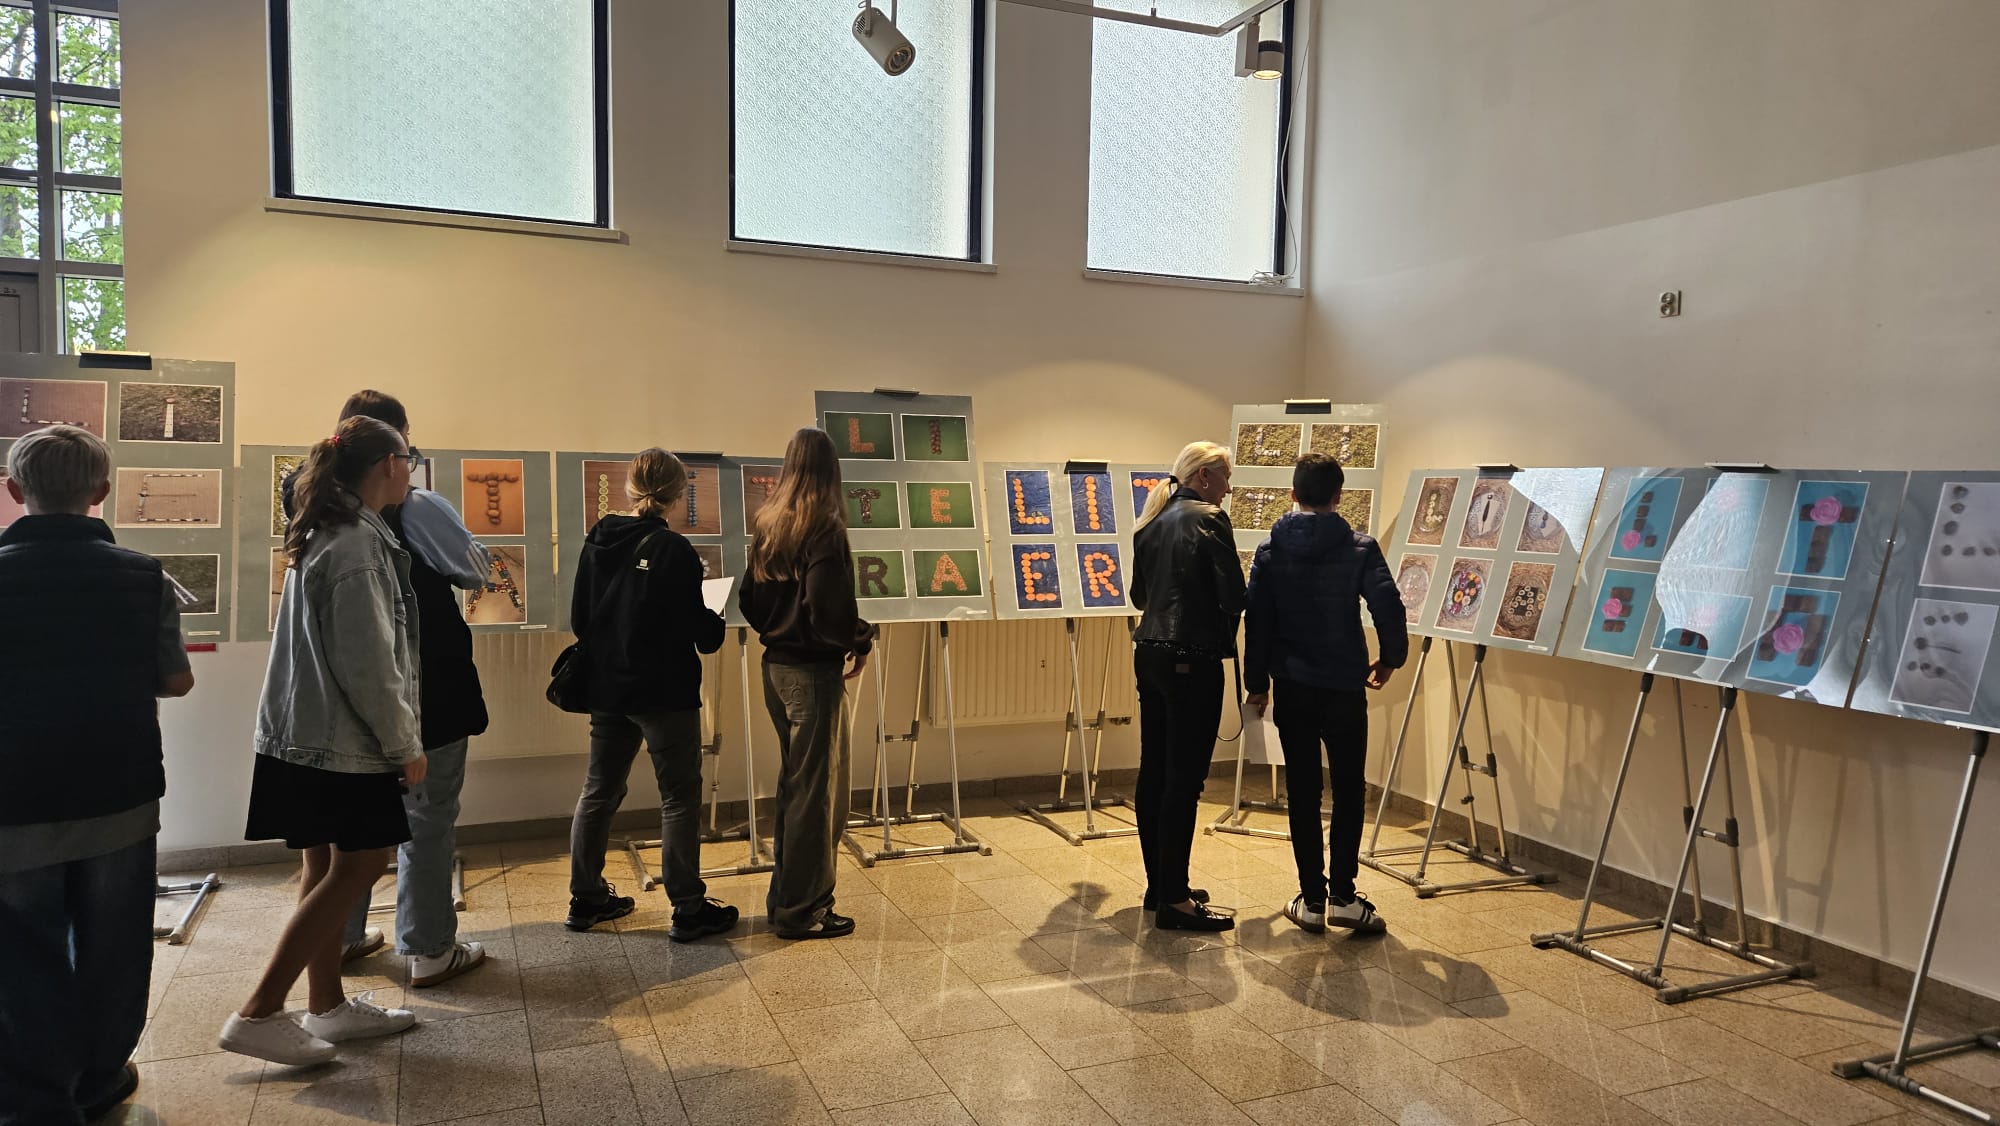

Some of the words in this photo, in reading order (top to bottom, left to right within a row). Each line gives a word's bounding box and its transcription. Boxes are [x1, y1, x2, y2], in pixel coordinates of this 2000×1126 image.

[848, 417, 875, 454] L
[928, 418, 943, 456] I
[466, 470, 520, 526] T
[847, 487, 881, 525] T
[929, 488, 953, 524] E
[1013, 477, 1051, 526] L
[1084, 475, 1101, 531] I
[1245, 492, 1276, 526] T
[1621, 490, 1658, 551] L
[1799, 496, 1859, 574] T
[857, 555, 889, 597] R
[931, 552, 968, 593] A
[1021, 551, 1058, 602] E
[1083, 551, 1120, 599] R
